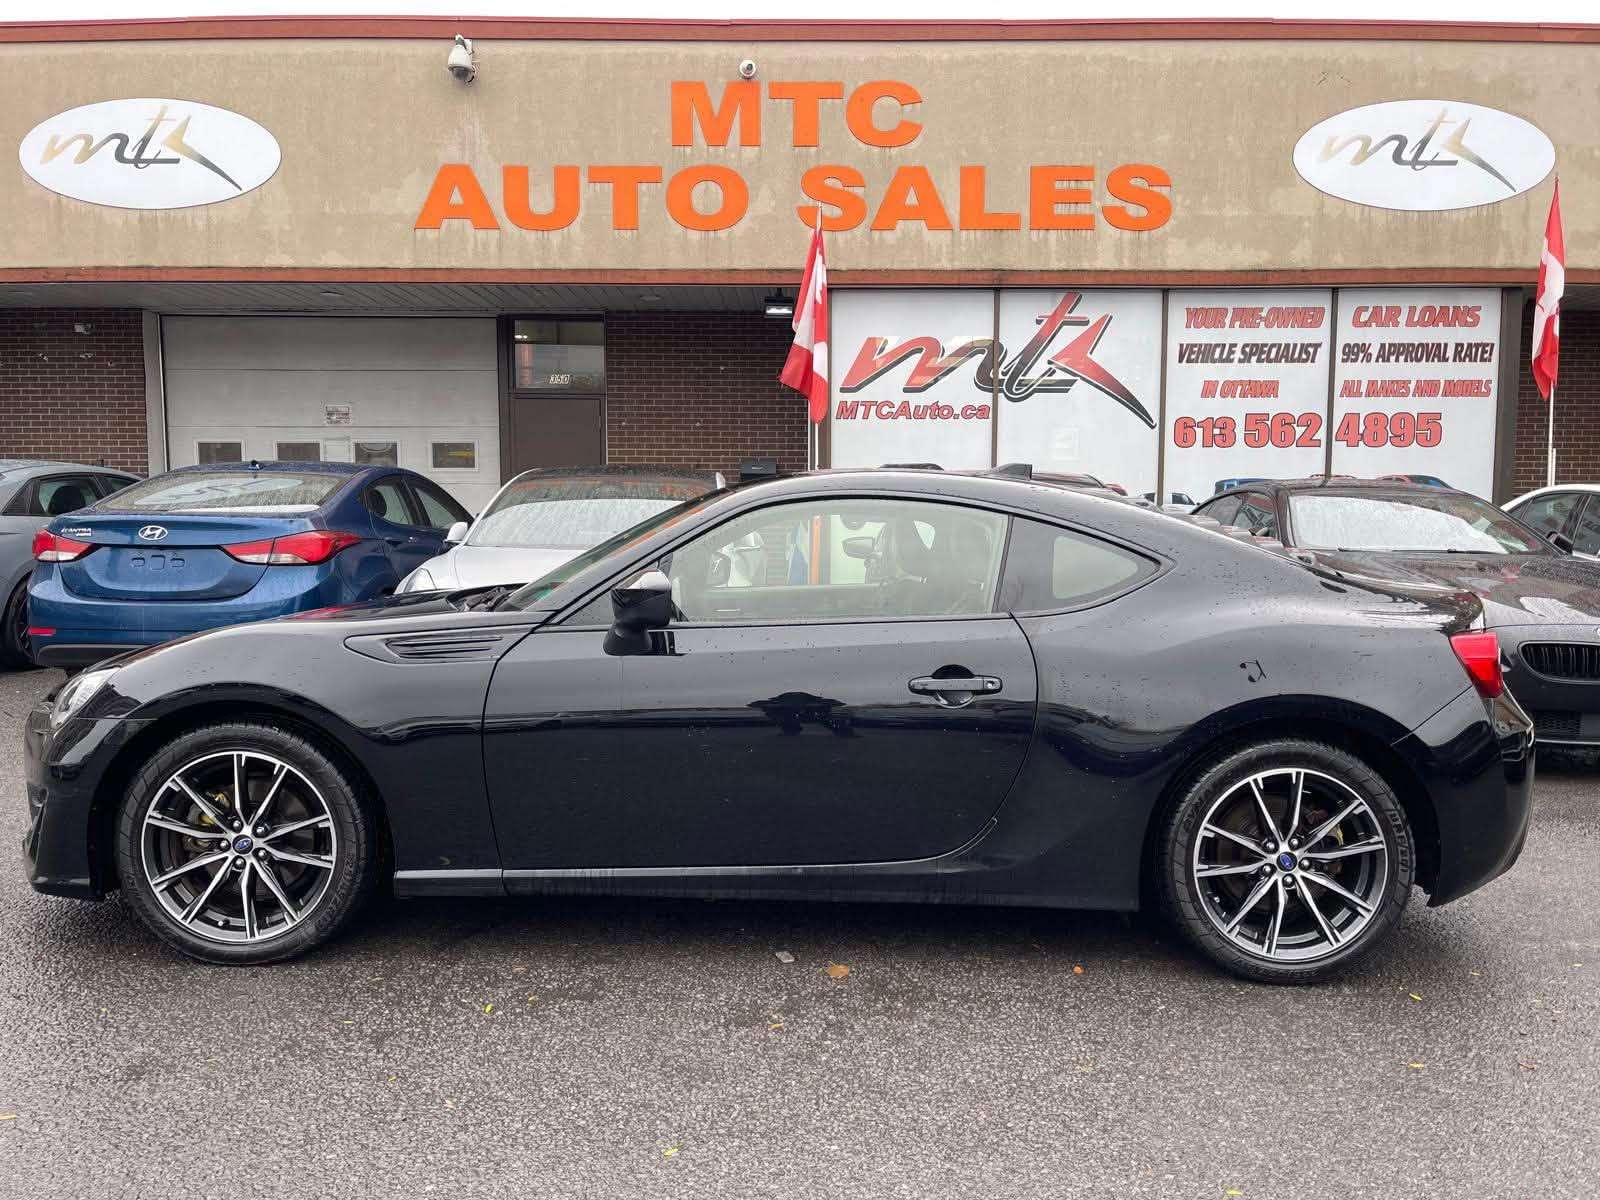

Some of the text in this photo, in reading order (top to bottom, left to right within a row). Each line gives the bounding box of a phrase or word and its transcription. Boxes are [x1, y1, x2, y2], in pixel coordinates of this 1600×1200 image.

[671, 81, 923, 147] MTC
[414, 165, 1173, 231] AUTO SALES
[1185, 306, 1325, 329] YOUR PRE-OWNED
[1351, 305, 1482, 328] CAR LOANS
[1178, 342, 1322, 364] VEHICLE SPECIALIST
[1341, 342, 1495, 363] 99% APPROVAL RATE!
[1200, 379, 1280, 399] IN OTTAWA
[1339, 379, 1492, 398] ALL MAKES AND MODELS
[835, 400, 991, 420] MTCAuto.ca
[1173, 412, 1442, 448] 613 562 4895
